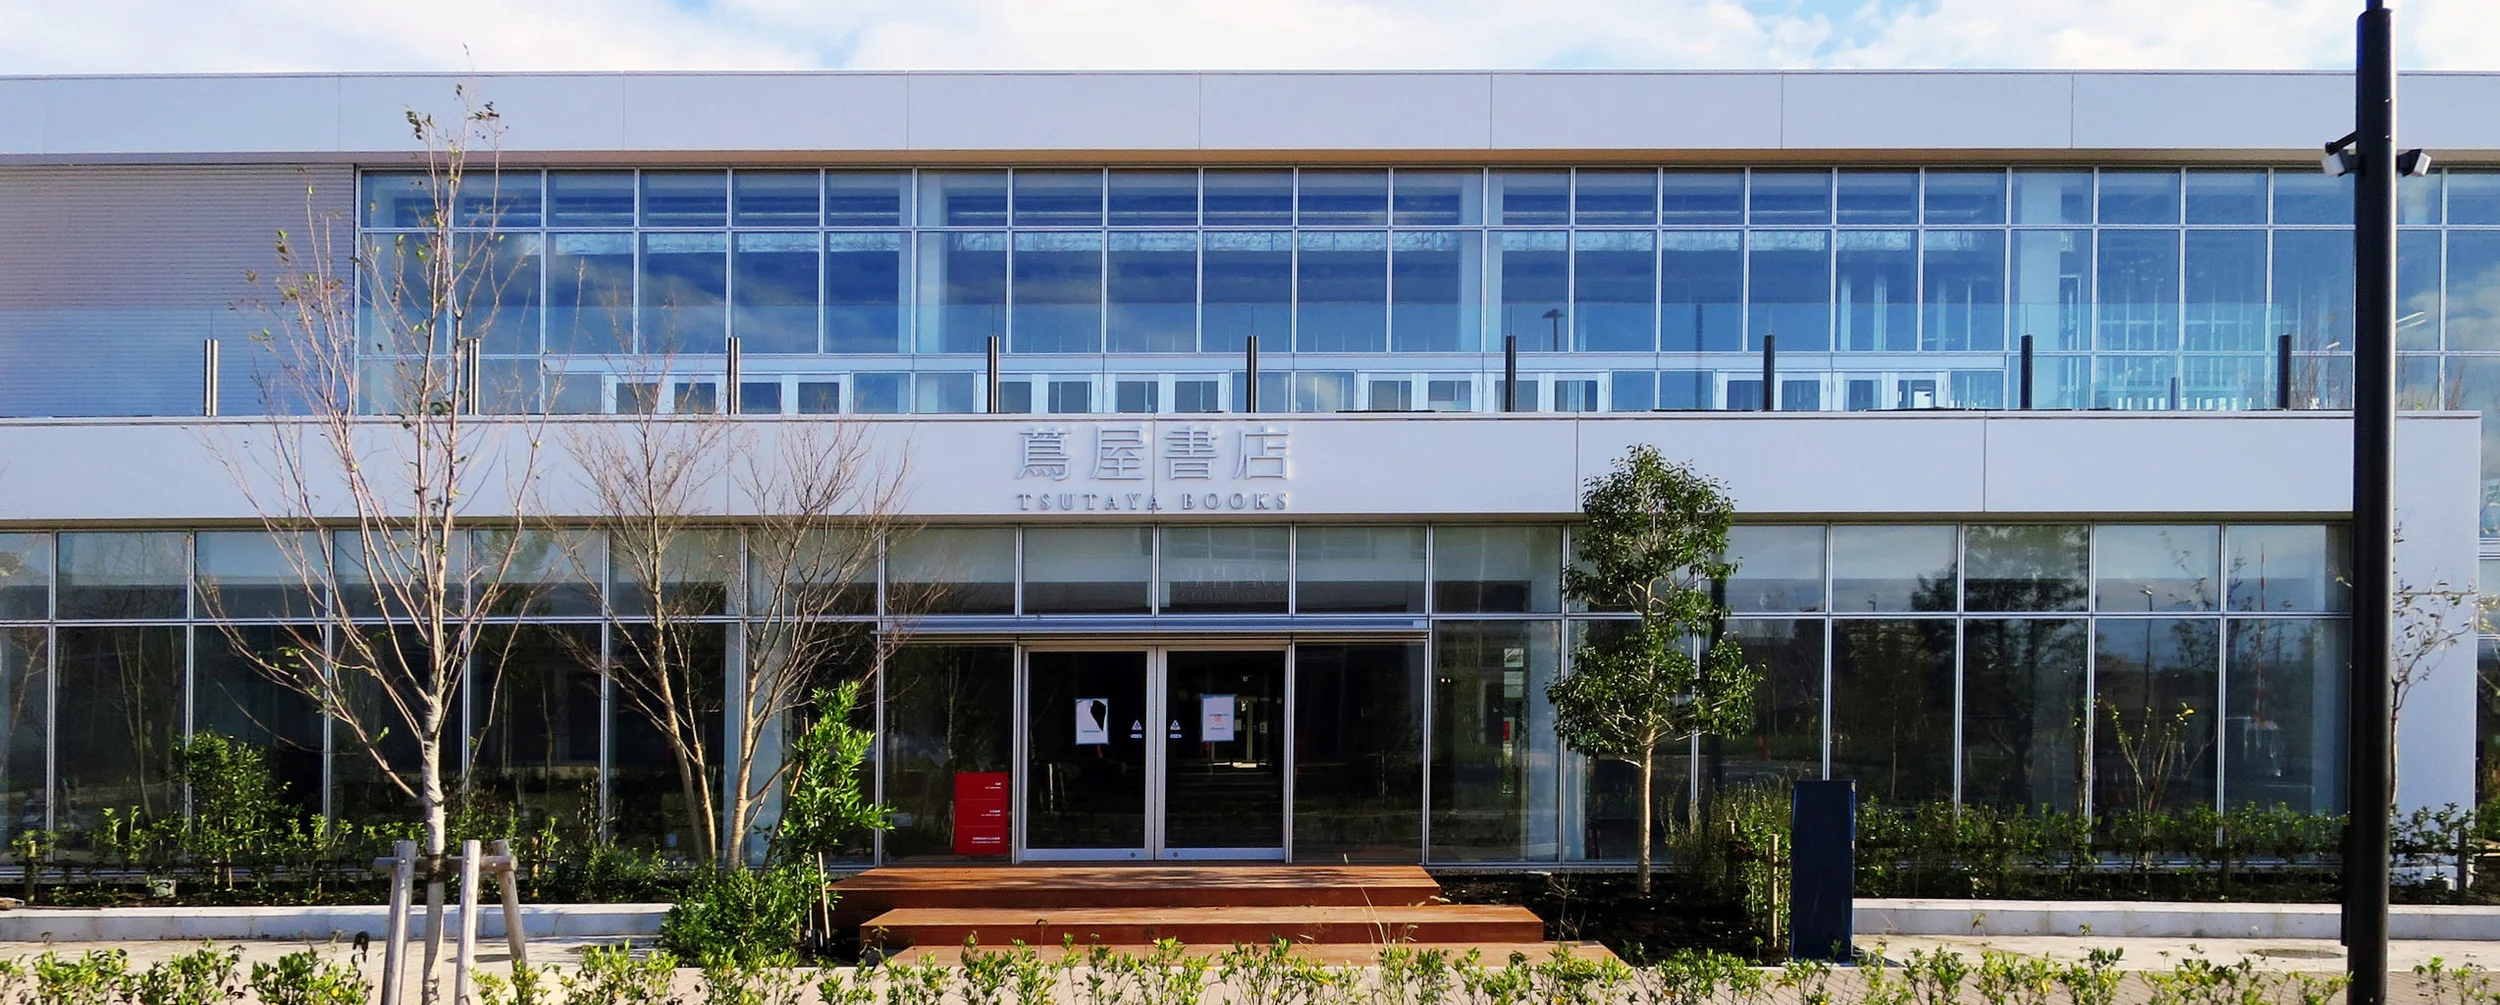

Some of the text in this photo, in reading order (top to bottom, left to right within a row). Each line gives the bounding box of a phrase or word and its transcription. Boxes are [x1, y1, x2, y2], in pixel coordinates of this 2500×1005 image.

[1017, 425, 1290, 481] 蔦屋書店
[1017, 492, 1290, 511] TSUTAYA BOOKS
